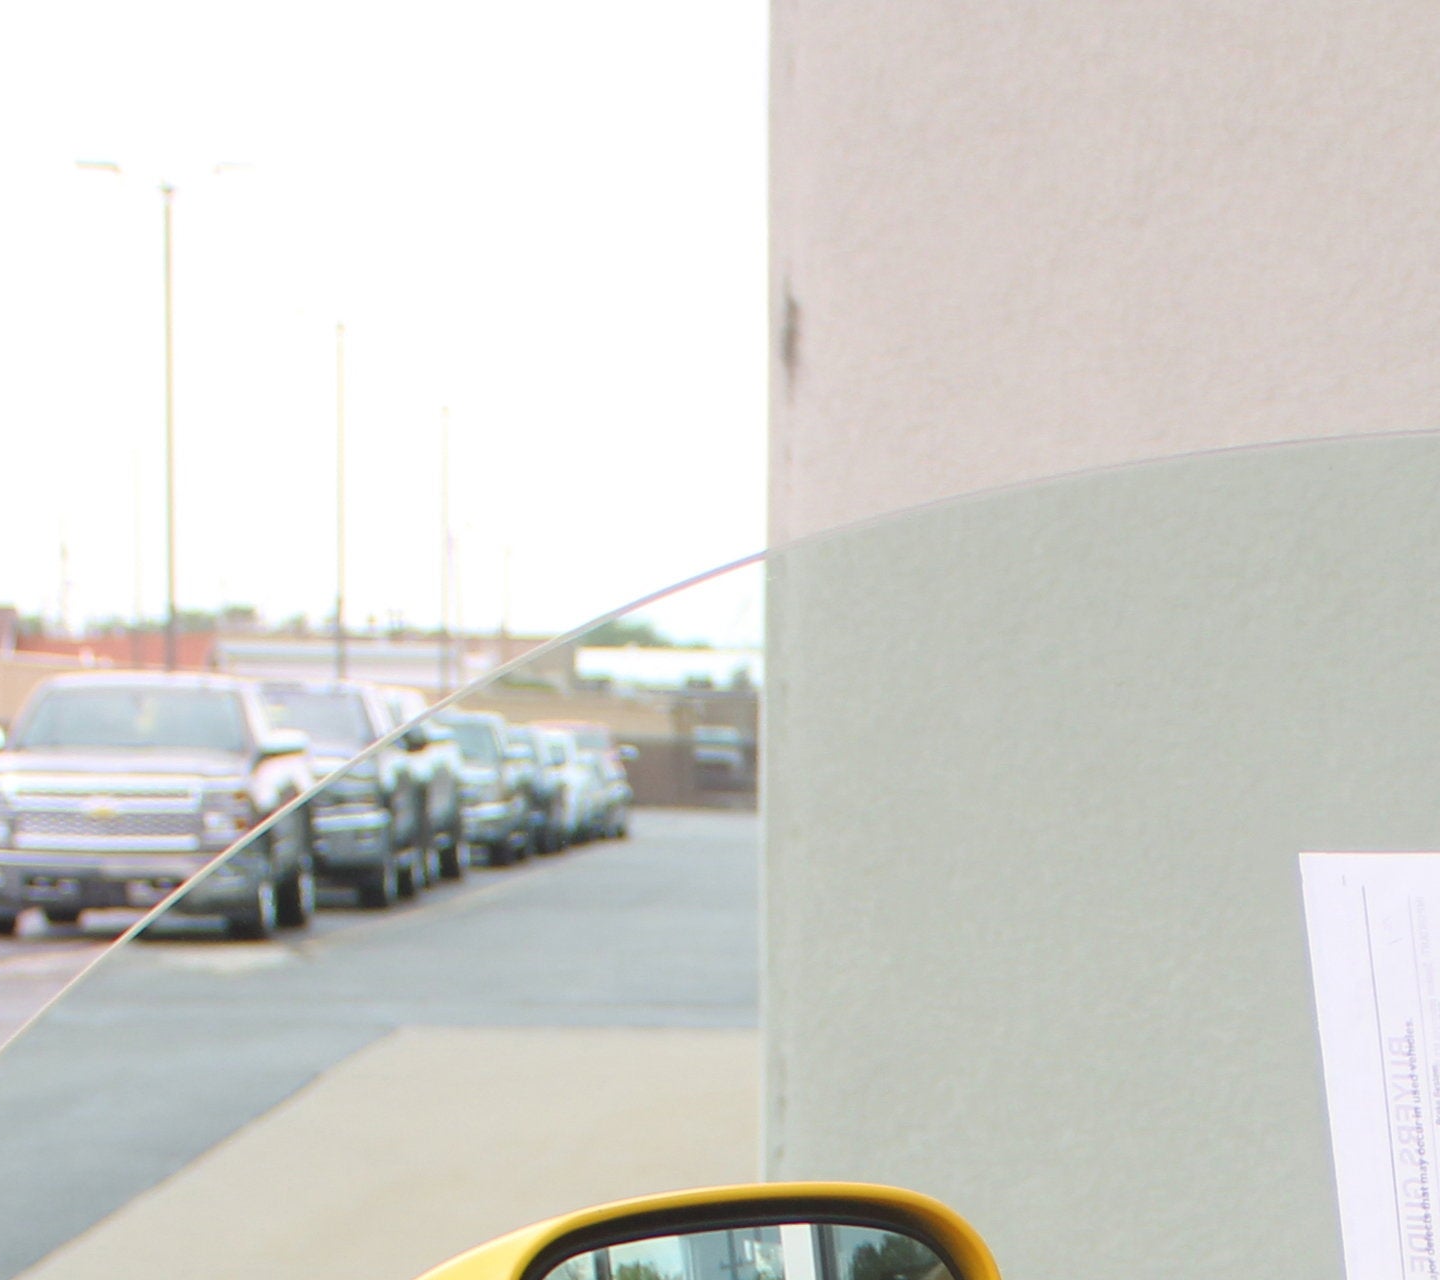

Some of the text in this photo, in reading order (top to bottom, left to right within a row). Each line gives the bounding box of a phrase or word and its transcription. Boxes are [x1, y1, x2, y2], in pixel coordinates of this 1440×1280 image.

[1402, 1017, 1417, 1070] vehicles.
[1408, 1074, 1420, 1103] used
[1411, 1106, 1422, 1117] in
[1412, 1119, 1425, 1155] occur
[1416, 1159, 1431, 1183] may
[1417, 1186, 1430, 1209] that
[1420, 1213, 1434, 1254] defects
